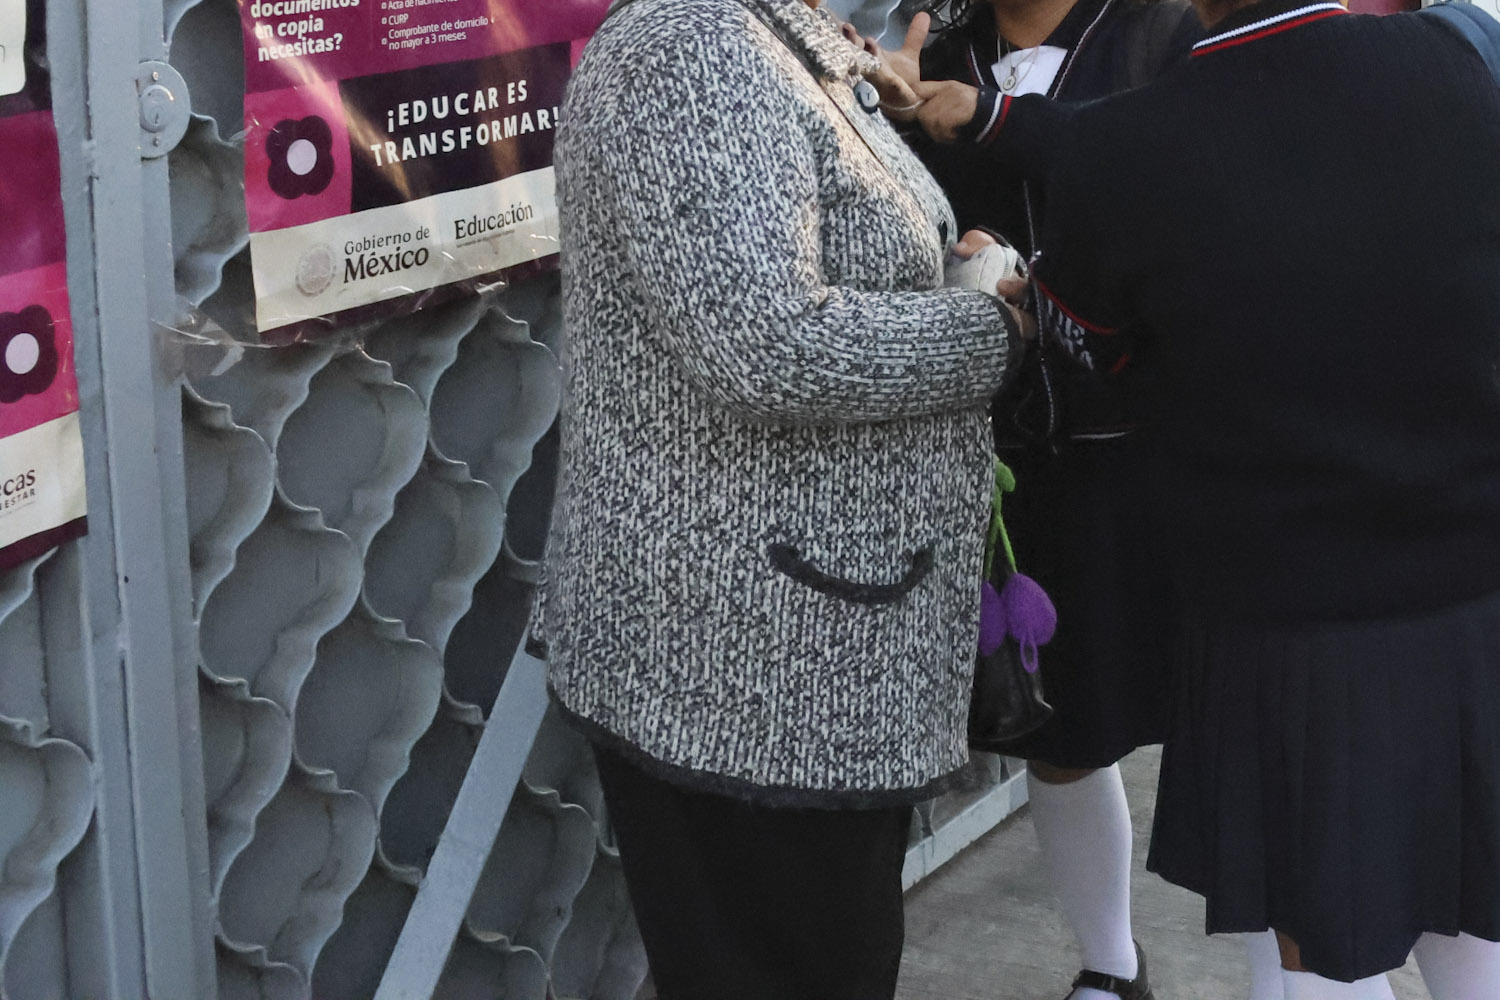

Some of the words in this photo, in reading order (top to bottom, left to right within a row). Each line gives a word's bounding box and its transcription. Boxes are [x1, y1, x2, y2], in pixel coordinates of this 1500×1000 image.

[388, 0, 404, 10] Acta
[254, 21, 274, 40] en
[277, 14, 324, 40] copia
[388, 13, 409, 26] CURP
[388, 23, 440, 39] Comprobante
[441, 21, 452, 32] de
[454, 16, 489, 29] domicilio
[258, 32, 343, 62] necesitas?
[388, 41, 400, 51] no
[401, 37, 423, 50] mayor
[431, 33, 437, 44] 3
[438, 31, 467, 43] meses
[387, 87, 499, 133] ¡EDUCAR
[506, 79, 528, 105] ES
[370, 106, 560, 167] TRANSFORMAR!
[454, 201, 534, 240] Educación
[344, 231, 412, 256] Gobierno
[415, 225, 431, 242] de
[343, 247, 430, 284] México
[0, 469, 36, 497] cas
[0, 488, 37, 511] ESTAR
